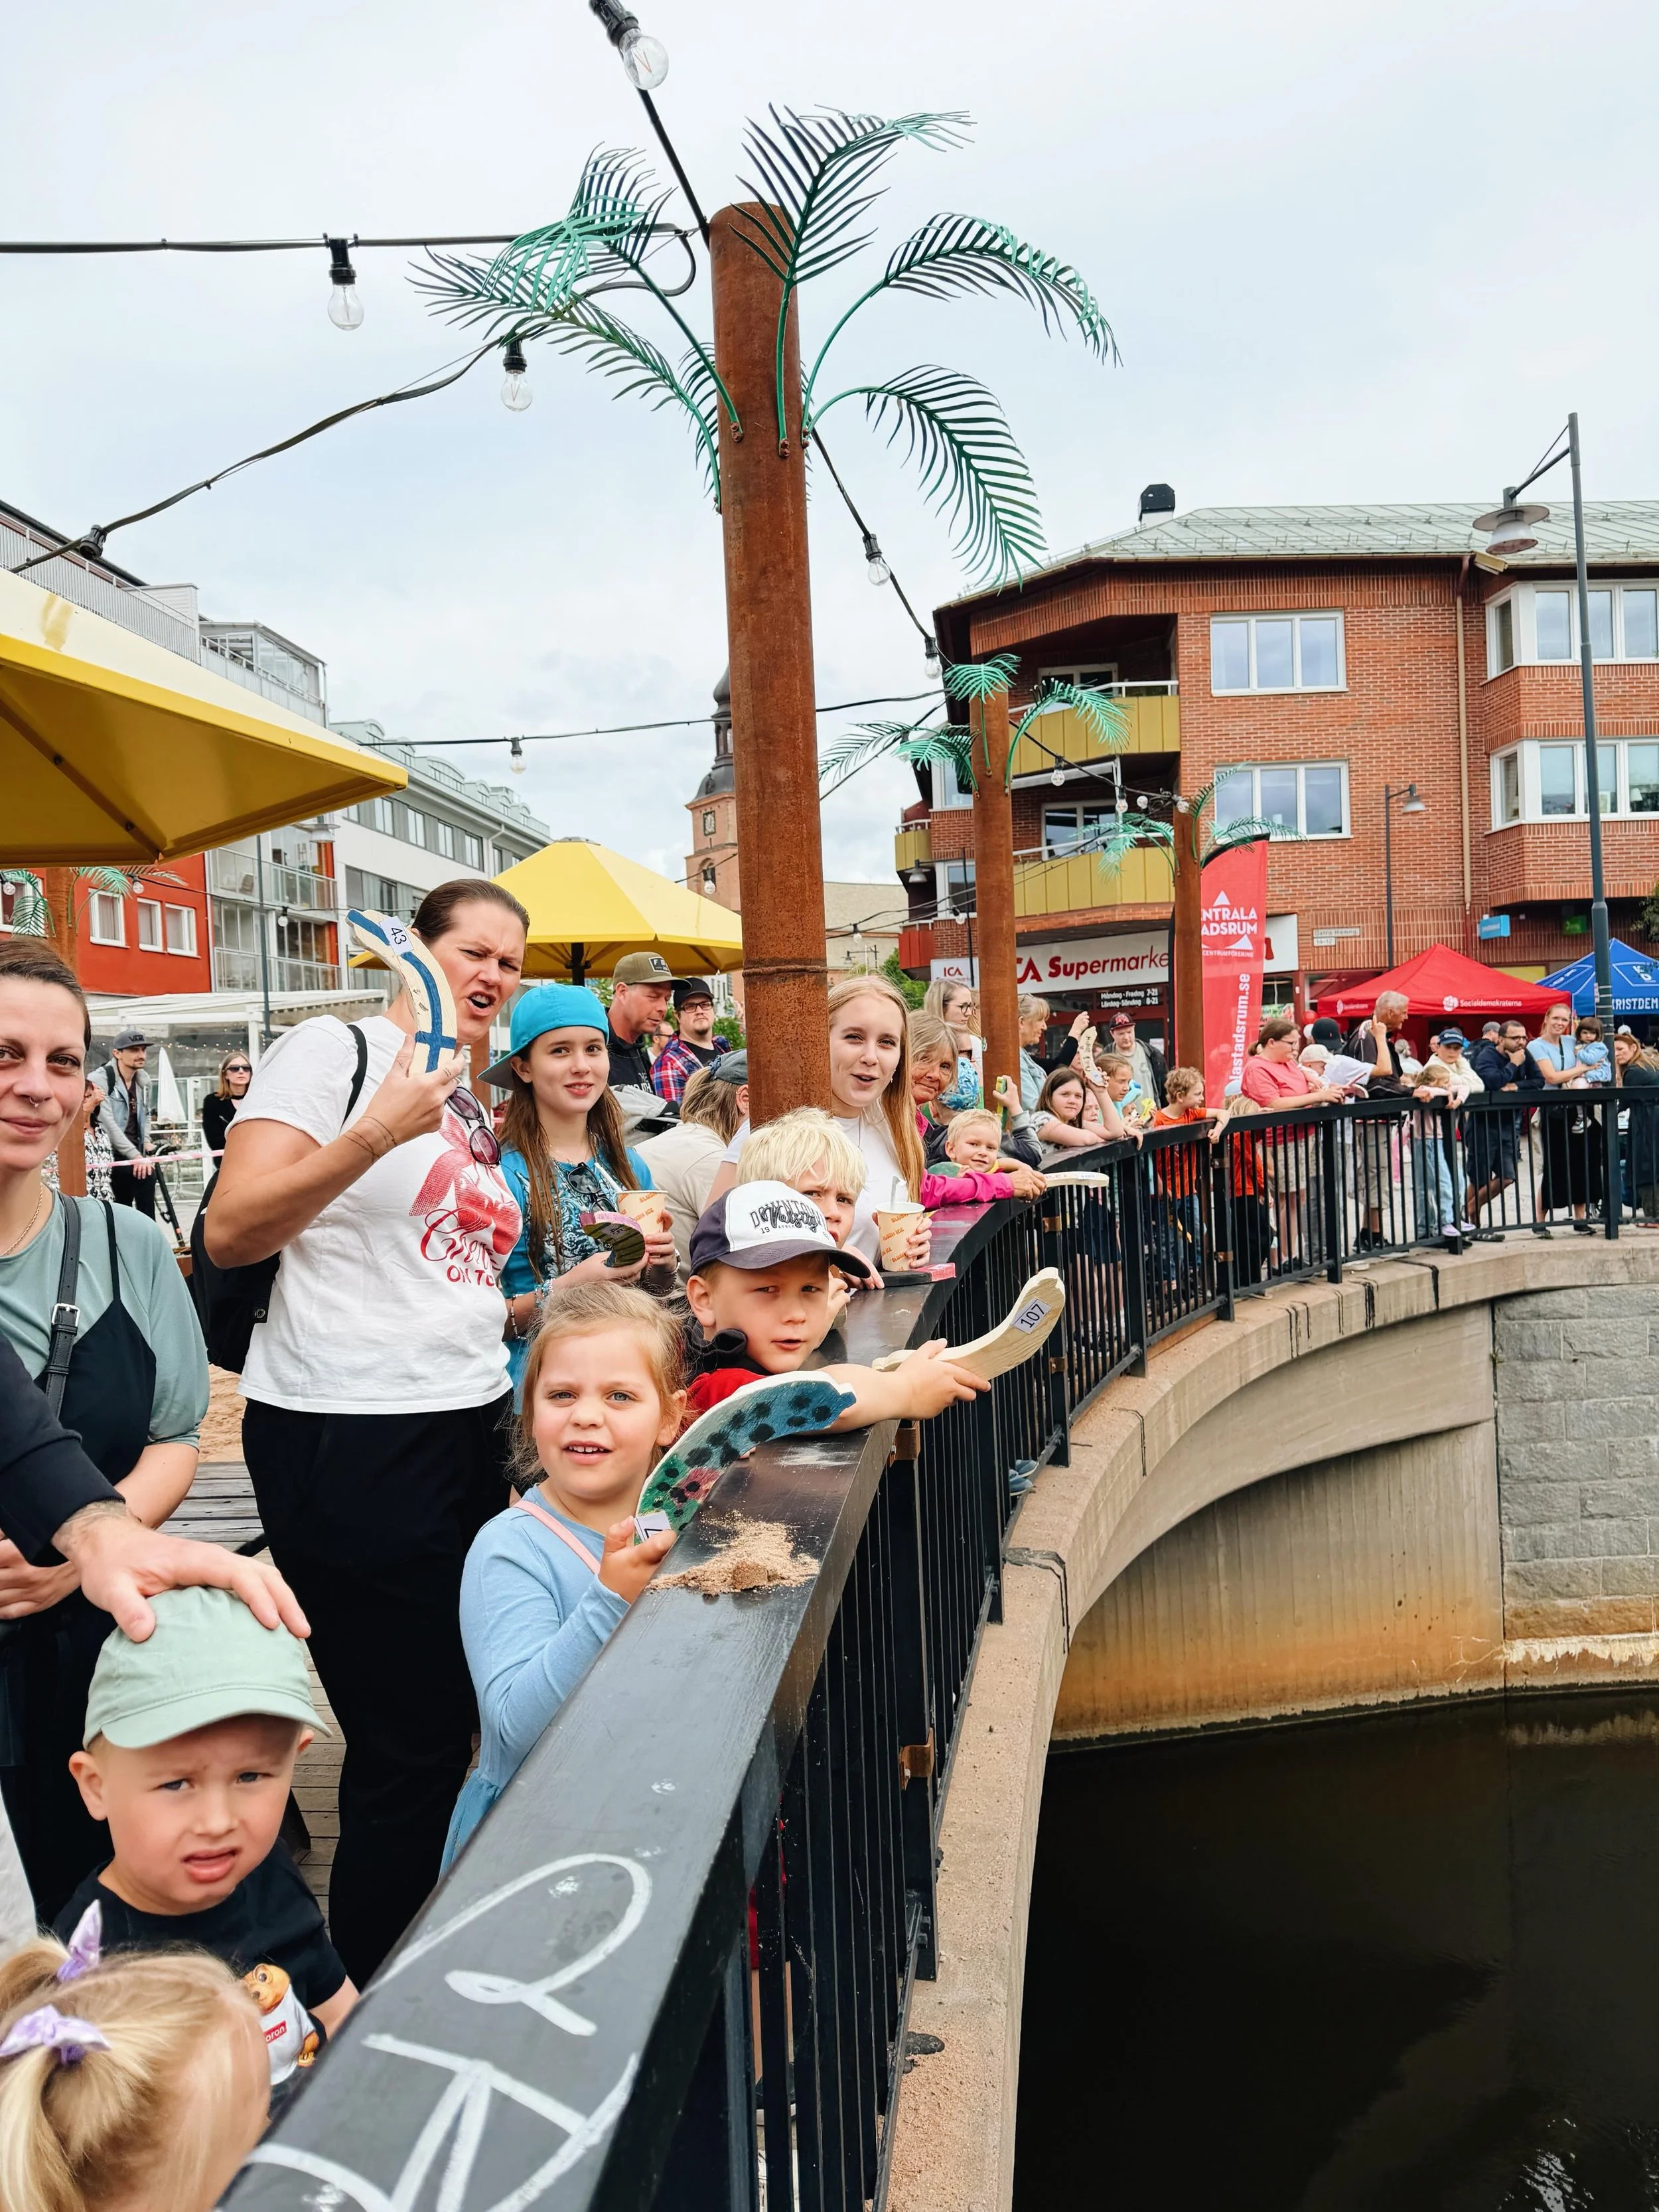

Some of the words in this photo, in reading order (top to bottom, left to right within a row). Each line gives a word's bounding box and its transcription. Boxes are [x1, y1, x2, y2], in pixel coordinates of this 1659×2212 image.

[391, 927, 407, 944] 43
[1201, 921, 1258, 936] ADSRUM
[944, 966, 963, 977] ICA
[447, 1265, 471, 1284] ON
[1021, 1303, 1045, 1328] 107
